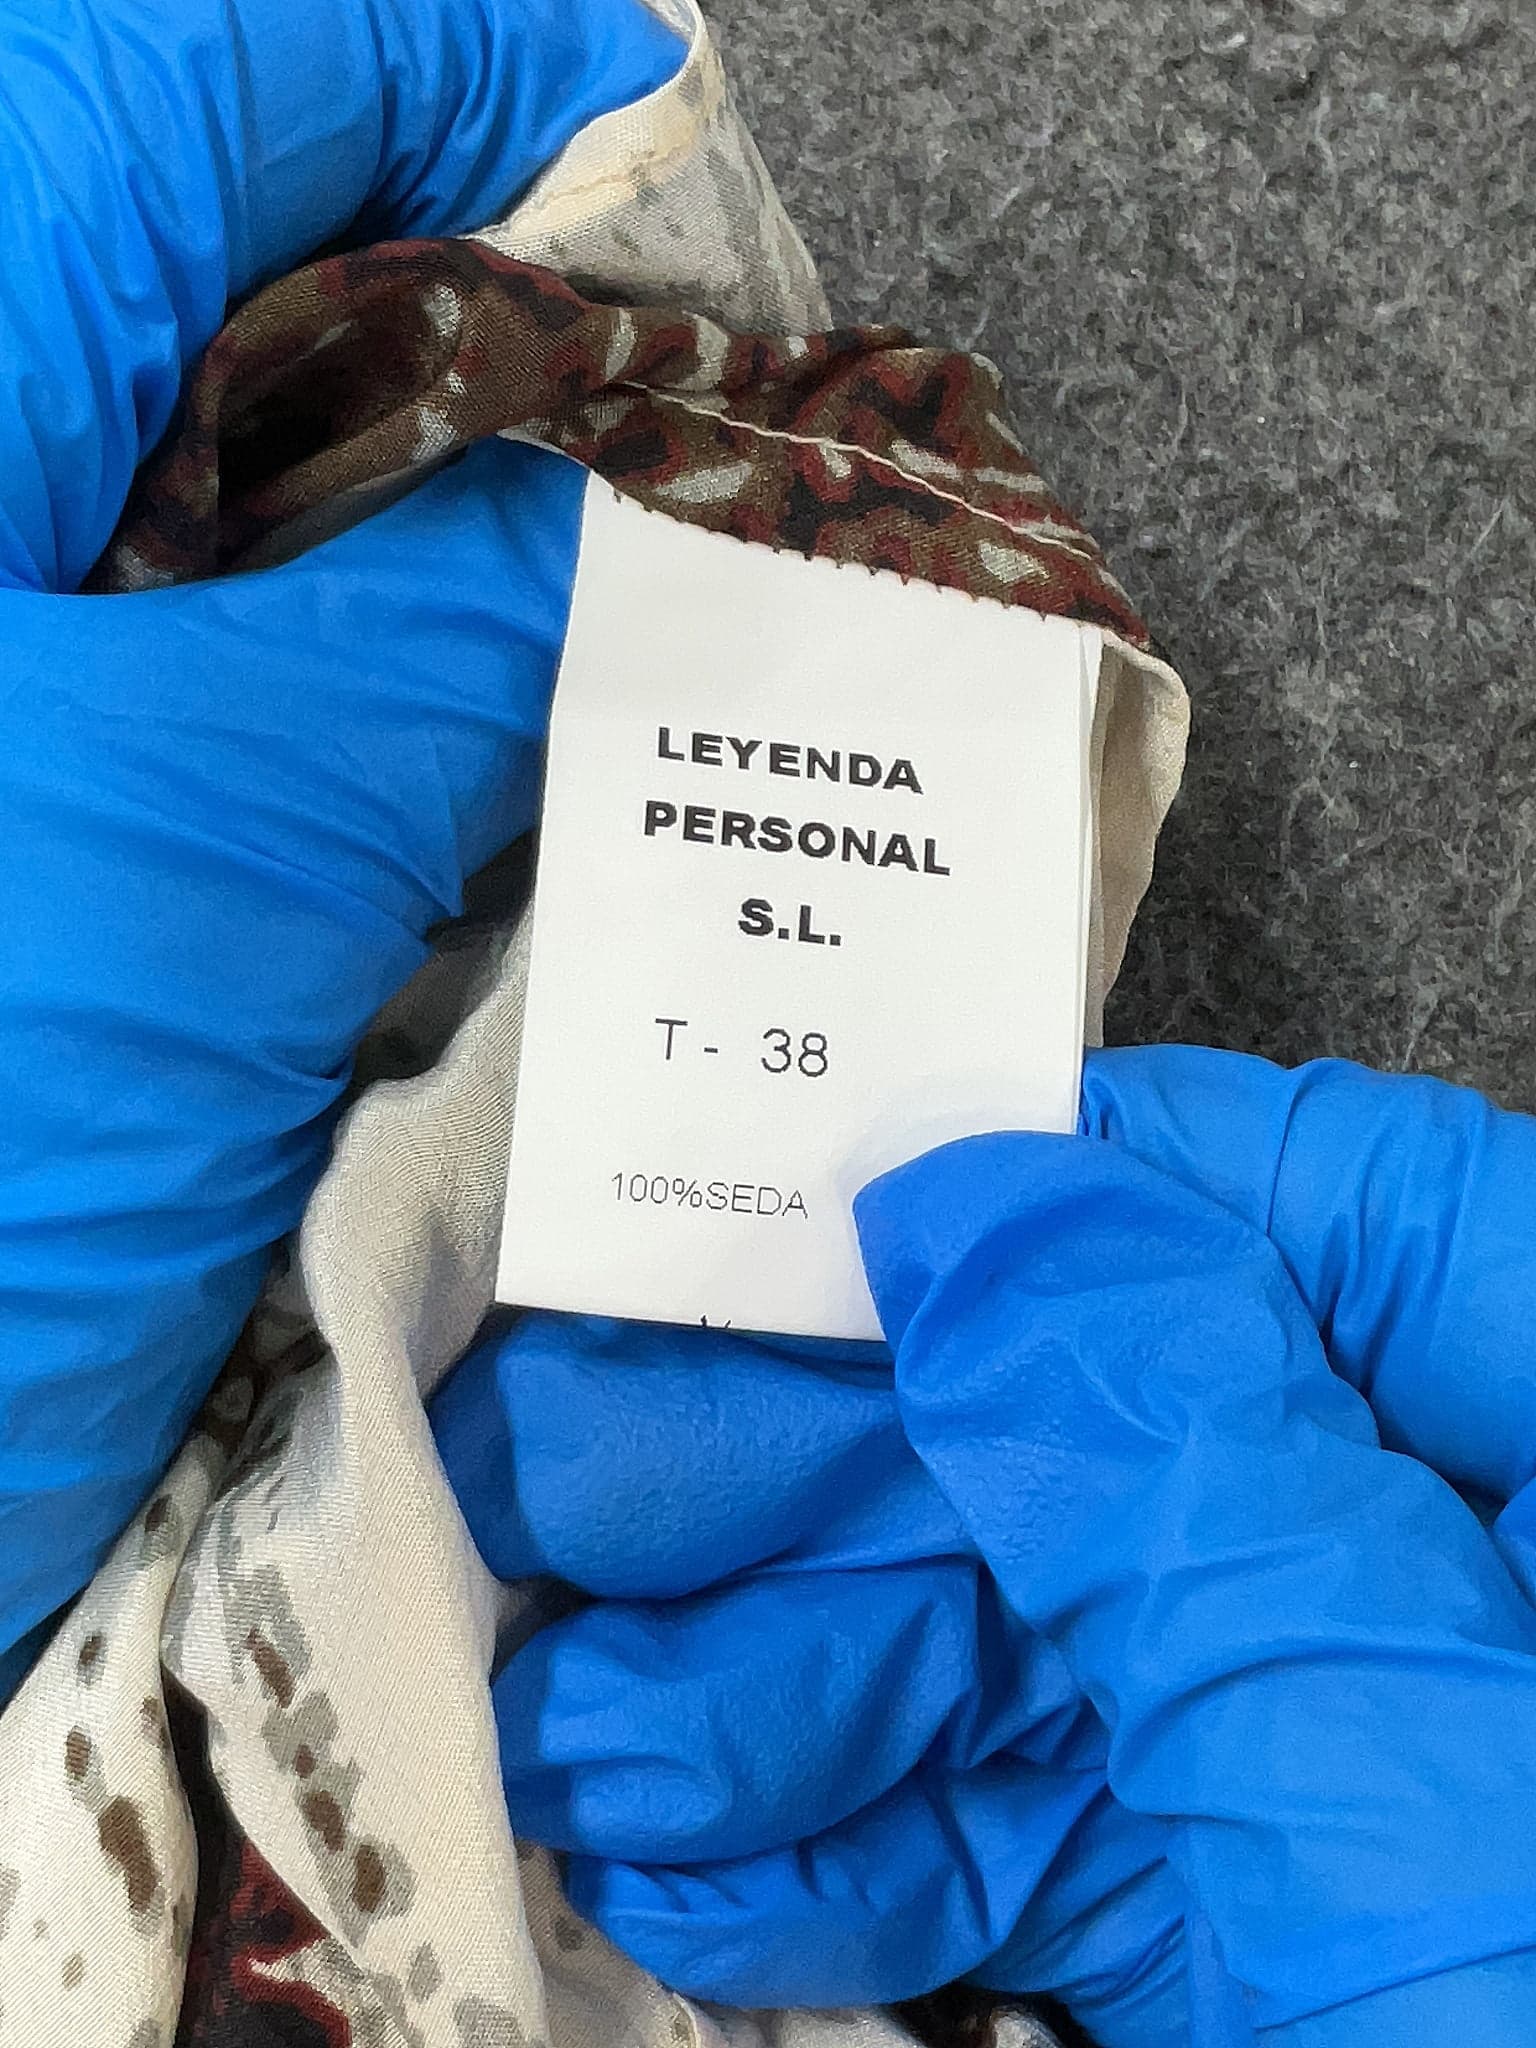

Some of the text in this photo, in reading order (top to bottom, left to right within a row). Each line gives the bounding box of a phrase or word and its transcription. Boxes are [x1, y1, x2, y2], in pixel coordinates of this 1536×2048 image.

[657, 725, 925, 796] LEYENDA
[643, 799, 951, 877] PERSONAL
[737, 897, 842, 947] S.L.
[760, 1027, 829, 1079] 38
[610, 1171, 809, 1220] 100%SEDA
